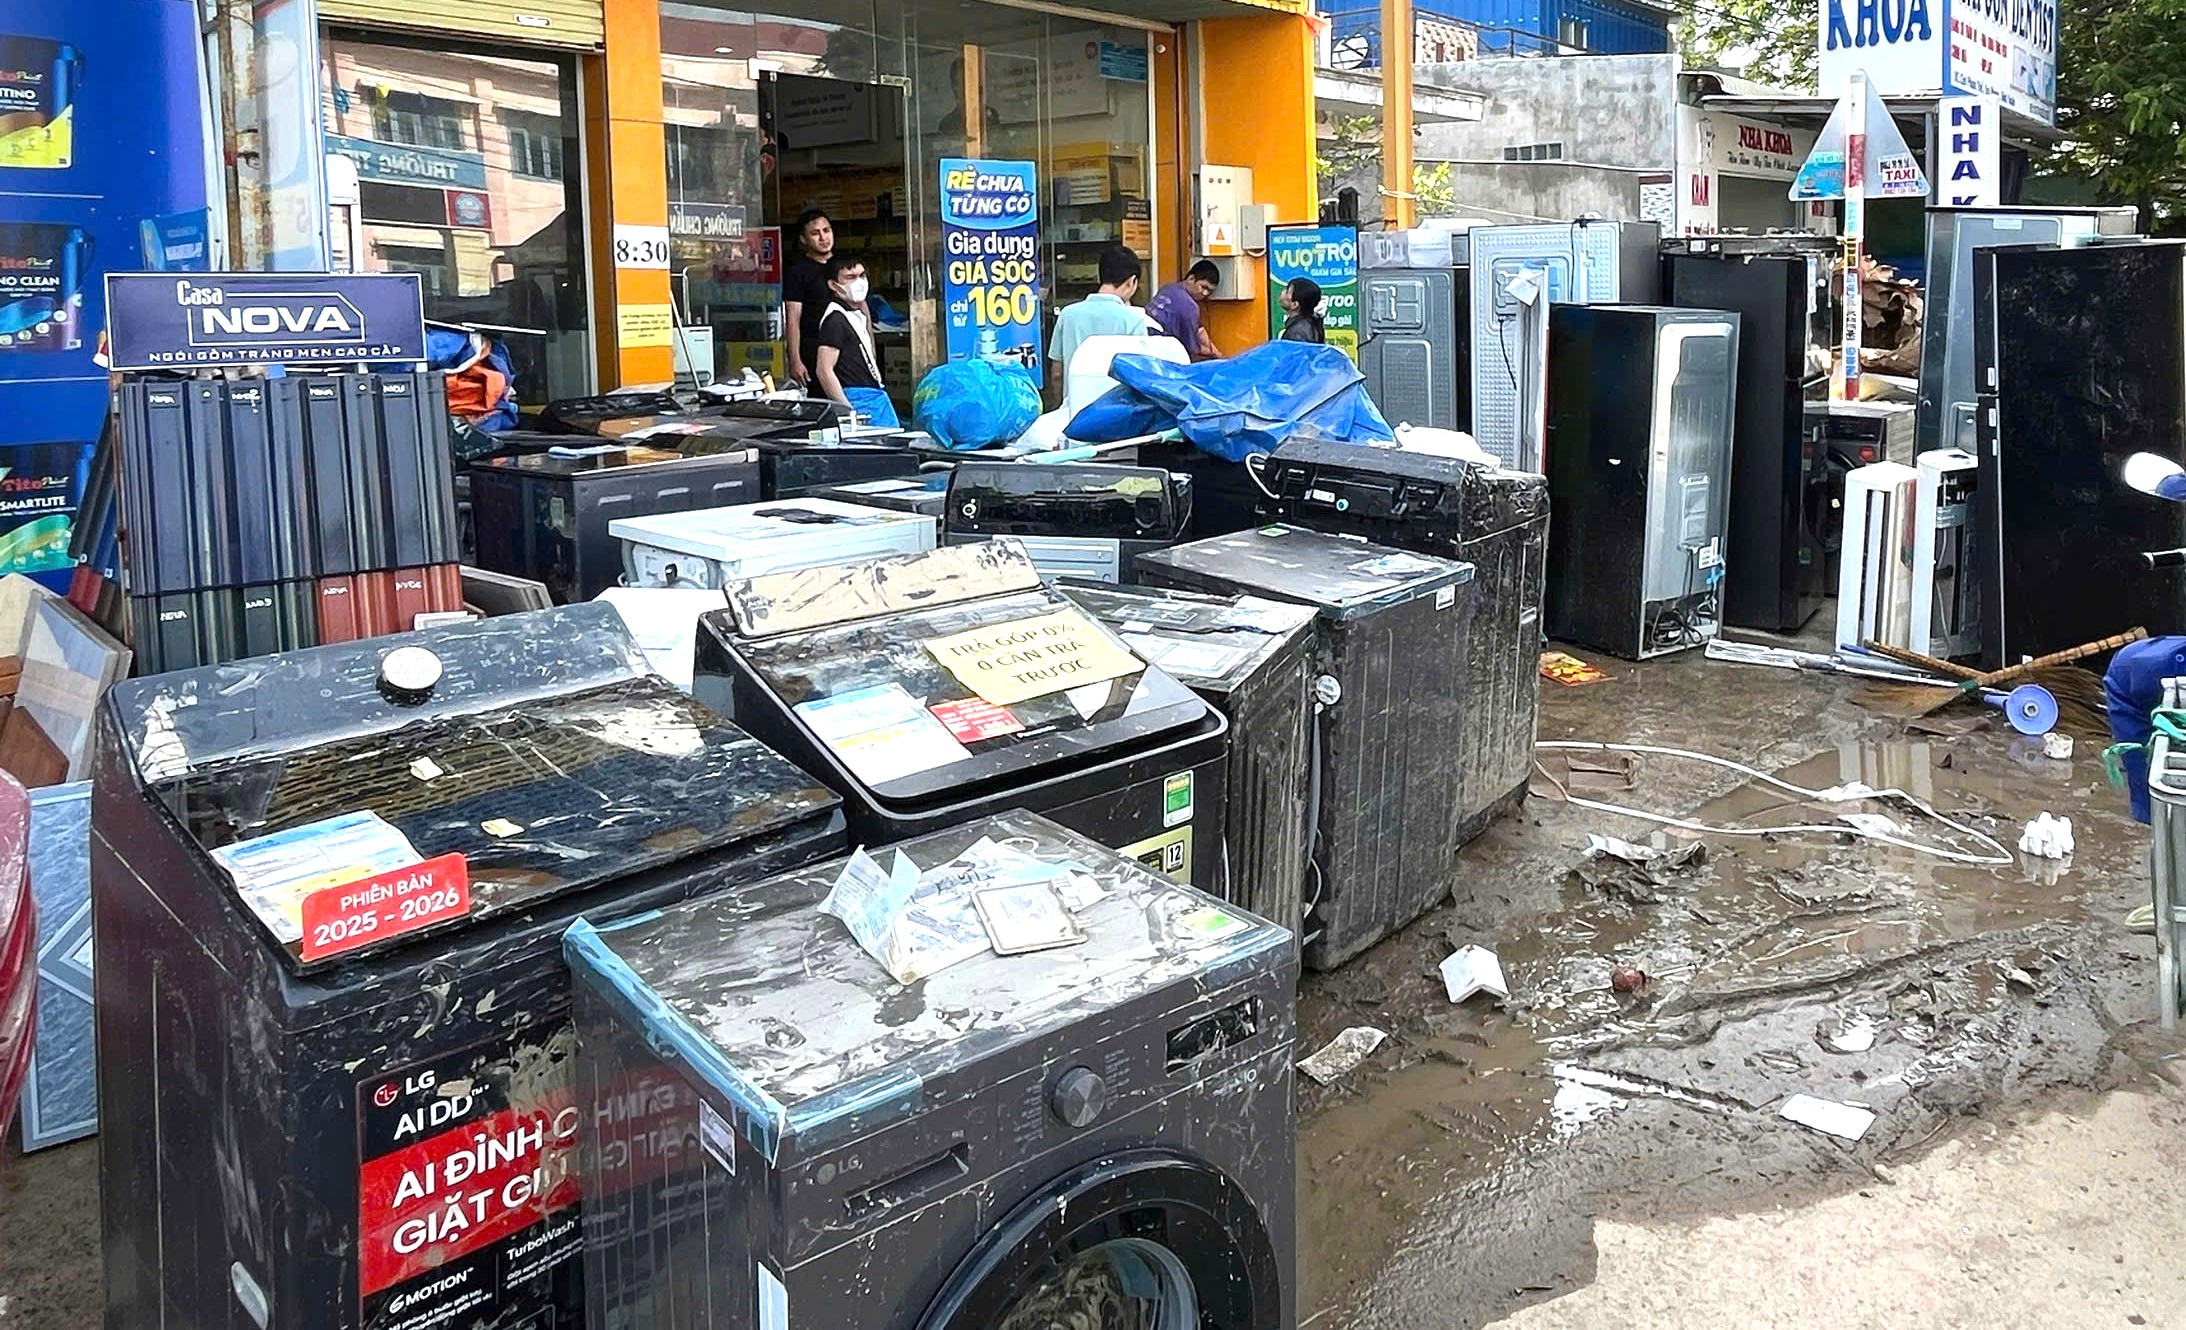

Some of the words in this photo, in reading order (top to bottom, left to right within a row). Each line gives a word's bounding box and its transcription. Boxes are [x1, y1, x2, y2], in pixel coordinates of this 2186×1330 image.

[1826, 0, 1932, 50] KHOA
[0, 87, 36, 99] TINO
[946, 164, 976, 190] RẺ
[977, 175, 1024, 192] CHƯA
[1885, 168, 1916, 181] TAXI
[951, 193, 1002, 214] TỪNG
[1004, 193, 1031, 213] CÓ
[616, 239, 668, 263] 8:30
[948, 231, 981, 255] Gia
[984, 231, 1035, 260] dụng
[20, 276, 60, 286] CLEAN
[949, 255, 989, 285] GIÁ
[990, 252, 1036, 285] SỐC
[176, 280, 223, 306] Casa
[967, 284, 1036, 327] 160
[202, 306, 351, 334] NOVA
[297, 348, 334, 358] MEN
[336, 347, 367, 357] CAO
[0, 495, 66, 511] SMARTLITE
[995, 630, 1038, 647] GÓP
[1169, 845, 1182, 862] 12
[340, 883, 394, 912] PHIÊN
[396, 873, 433, 895] BẢN
[313, 910, 378, 947] 2025
[399, 887, 460, 921] 2026
[405, 1069, 435, 1096] LG
[393, 1107, 424, 1141] AI
[391, 1162, 435, 1209] AI
[443, 1119, 543, 1187] ĐỈNH
[838, 1154, 860, 1175] LG
[392, 1190, 495, 1254] GIẶT
